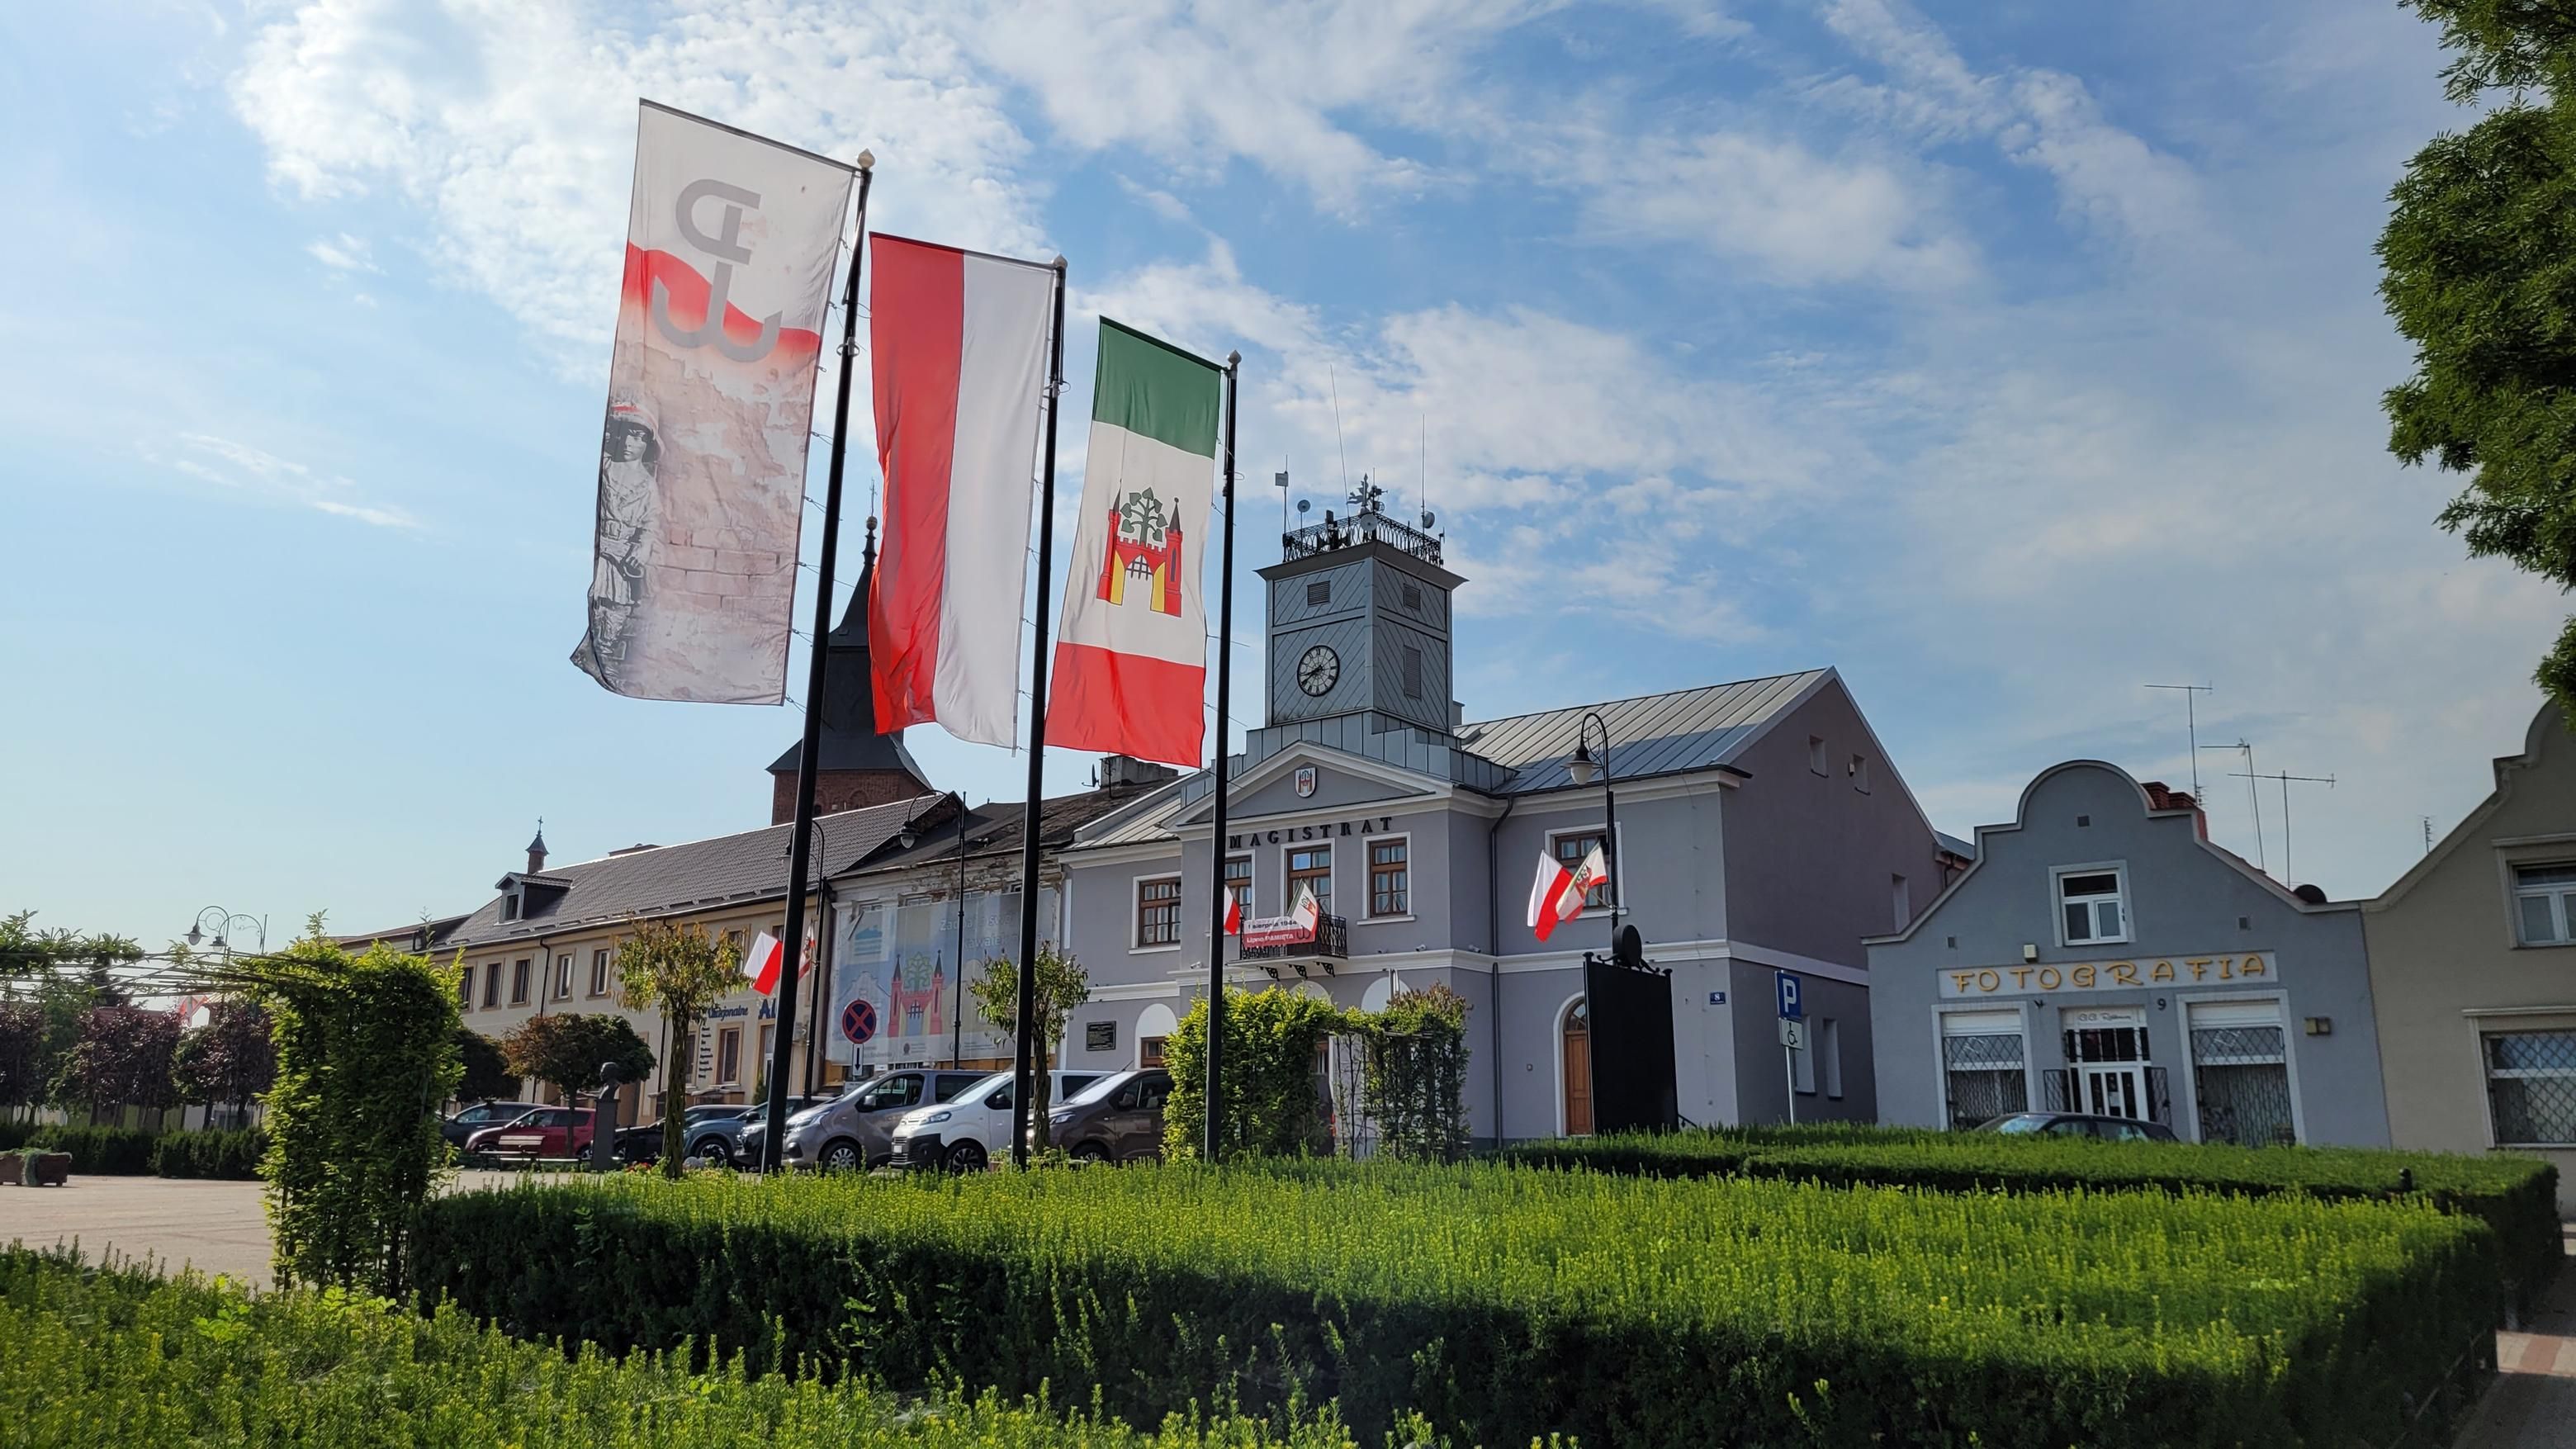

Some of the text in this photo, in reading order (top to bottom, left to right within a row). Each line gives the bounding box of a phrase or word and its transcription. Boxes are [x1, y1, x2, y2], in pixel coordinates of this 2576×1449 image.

[1229, 817, 1392, 849] MAGISTRAT
[1951, 954, 2265, 992] FOTOGRAFIA
[1783, 978, 1797, 1012] P
[2157, 997, 2166, 1011] 9
